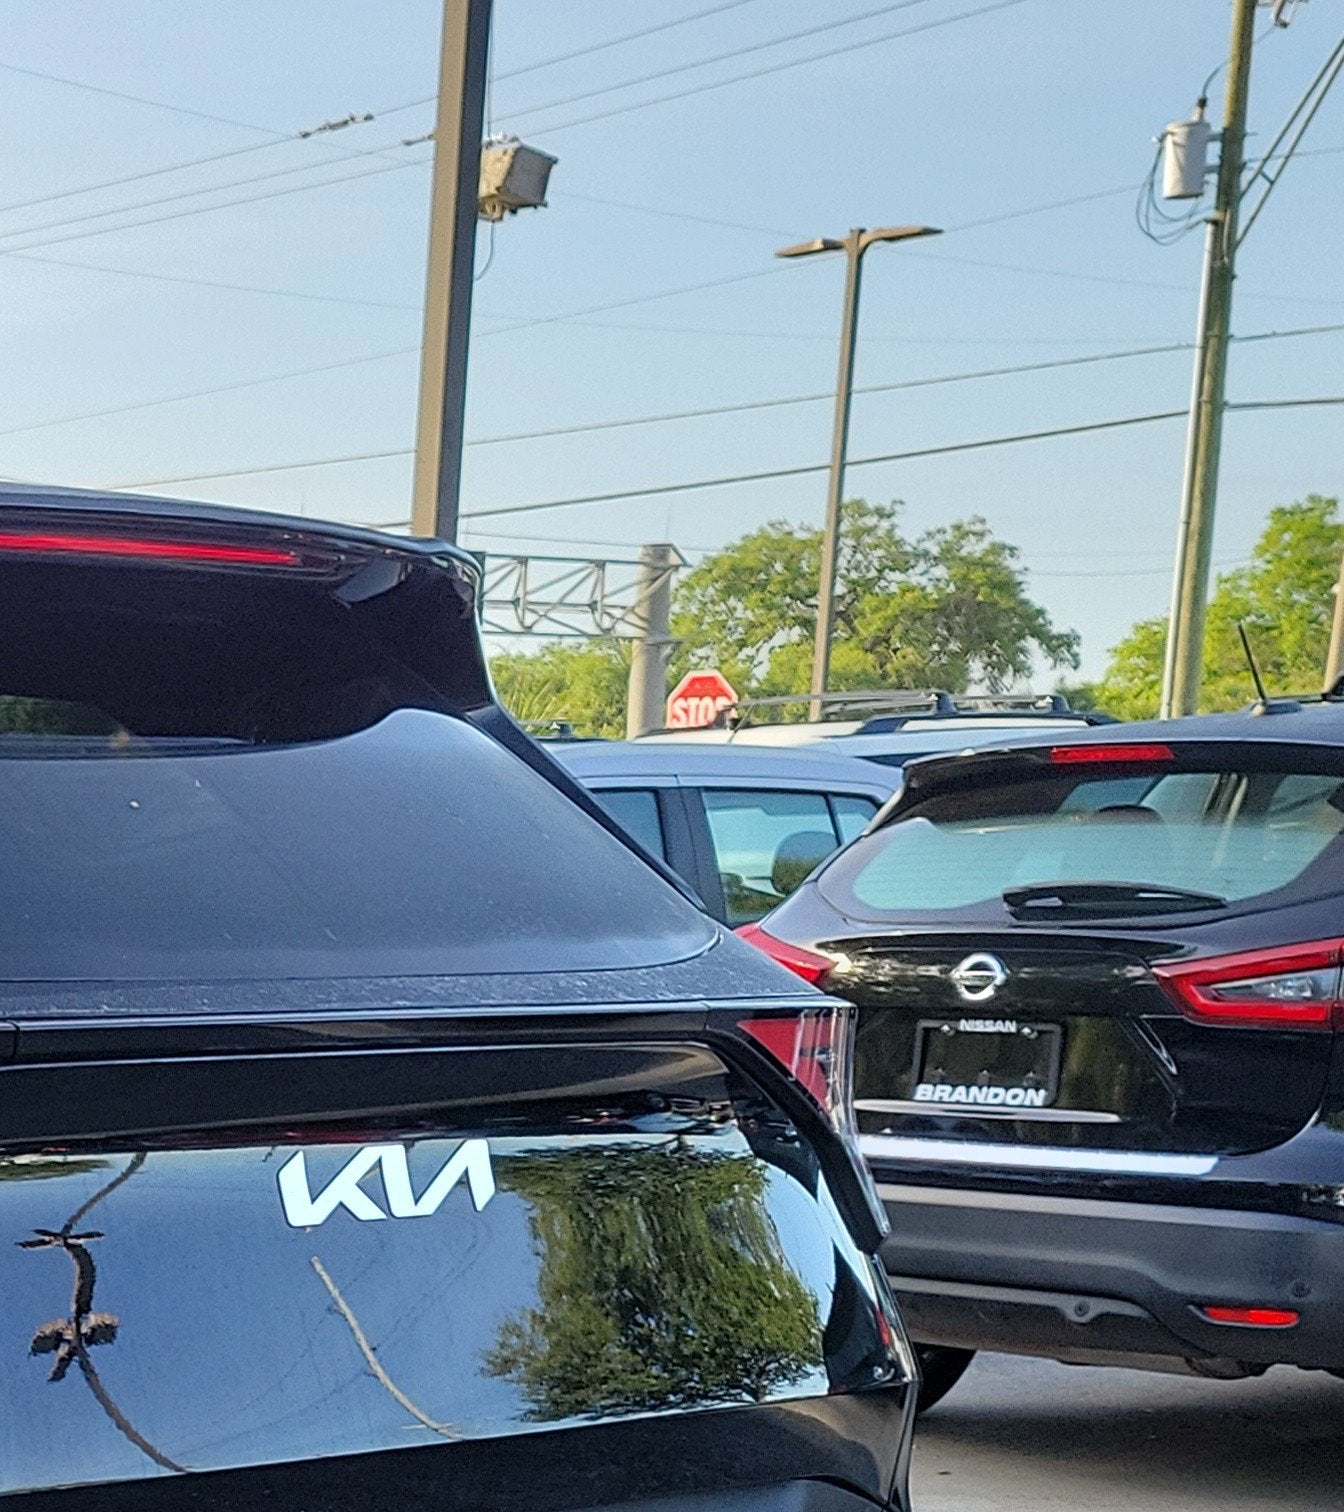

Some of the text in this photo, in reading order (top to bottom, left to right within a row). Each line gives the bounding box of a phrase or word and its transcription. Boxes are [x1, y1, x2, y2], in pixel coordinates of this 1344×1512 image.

[959, 1018, 1017, 1034] NISSAN
[913, 1083, 1048, 1107] BRANDON
[276, 1138, 497, 1228] KIA
